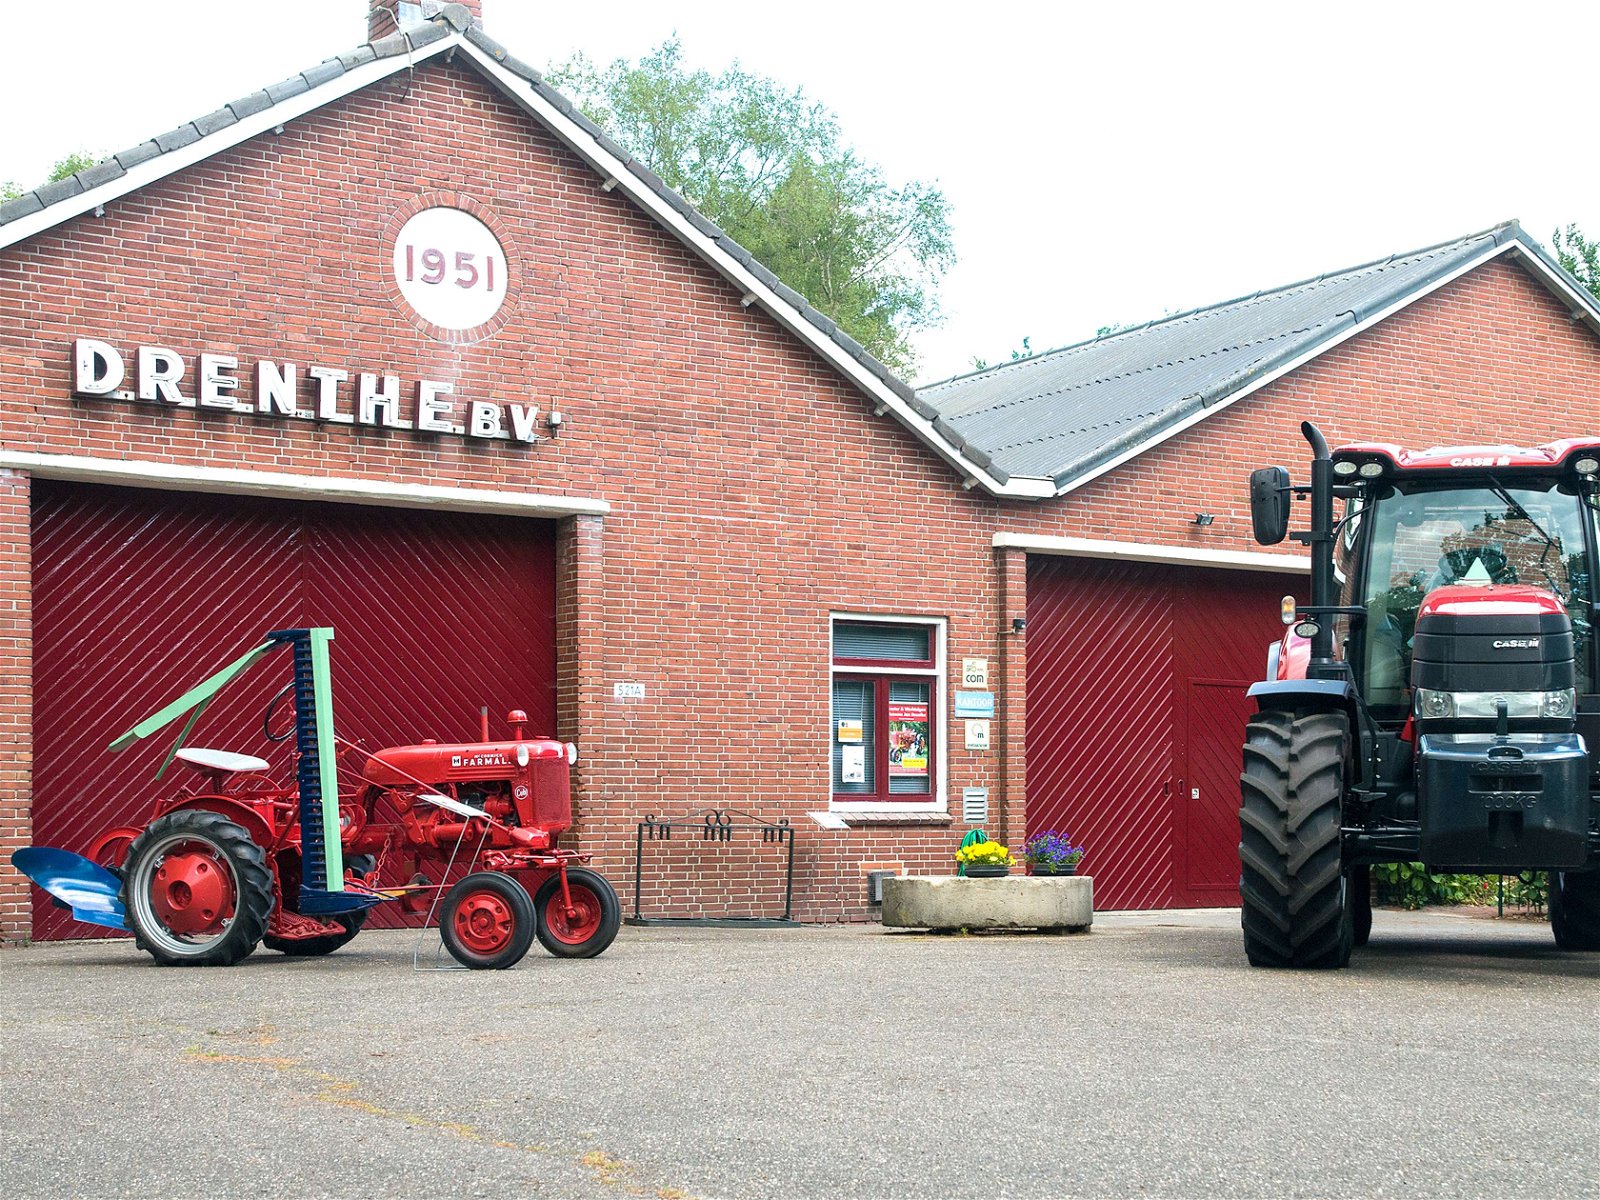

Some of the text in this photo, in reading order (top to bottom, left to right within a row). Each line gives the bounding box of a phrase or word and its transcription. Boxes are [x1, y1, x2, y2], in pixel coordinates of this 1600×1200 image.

[406, 244, 494, 291] 1951
[73, 338, 539, 443] DRENTHE BV
[1450, 457, 1494, 467] CASE
[1493, 640, 1527, 648] CASE
[957, 697, 993, 707] KANTOOR
[463, 756, 512, 767] FARMAL
